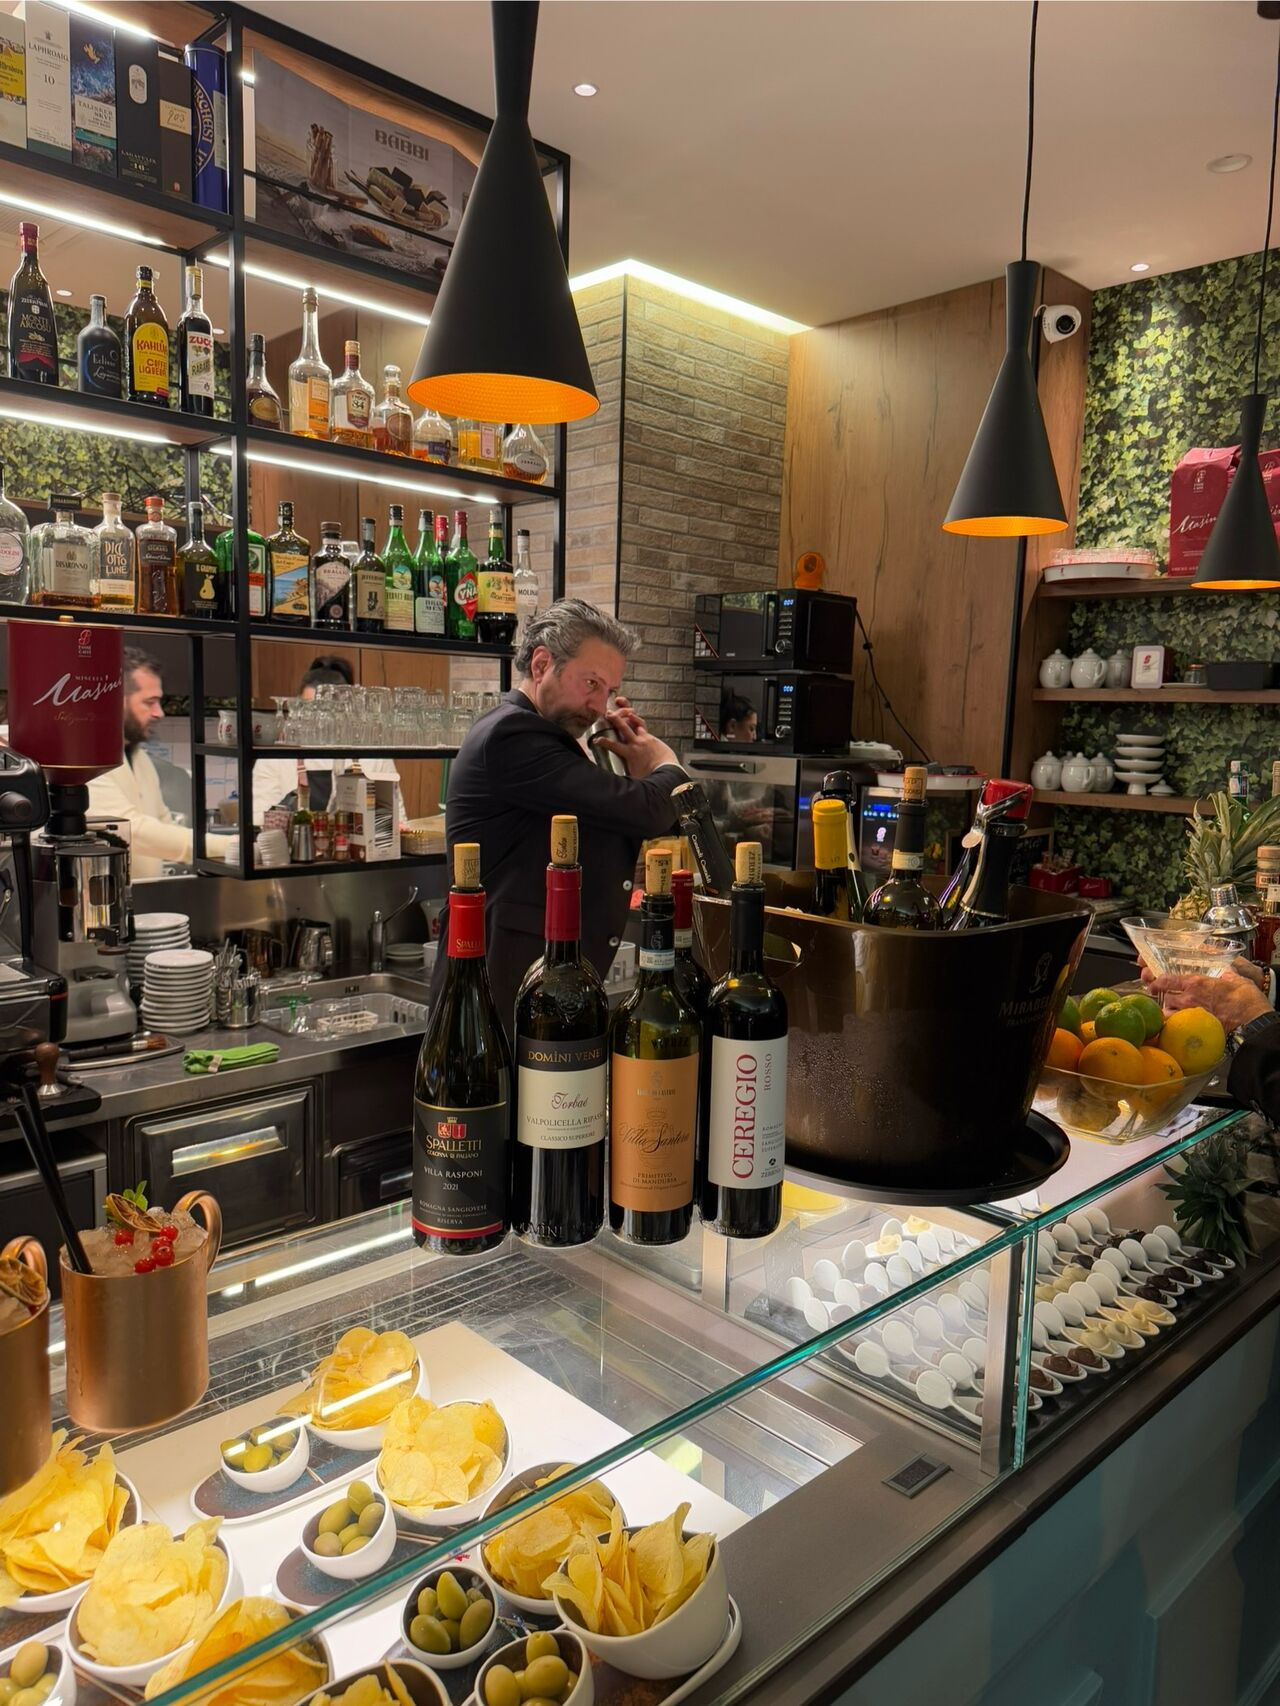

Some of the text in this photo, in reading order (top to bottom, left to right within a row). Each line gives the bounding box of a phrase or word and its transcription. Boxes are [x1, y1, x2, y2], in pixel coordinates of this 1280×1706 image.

[28, 42, 69, 62] LAPHROAIG
[44, 74, 55, 86] 10
[375, 128, 430, 161] BABBI
[55, 560, 89, 570] DISARONNO
[763, 1053, 773, 1091] ROSSO
[526, 1115, 582, 1127] VALPOLICELLA
[731, 1054, 758, 1179] CEREGIO
[426, 1135, 482, 1152] SPALLETTI
[424, 1166, 483, 1179] VILLA RASPONI
[637, 1171, 673, 1179] PRIMITIVO
[443, 1183, 459, 1191] 2021
[420, 1200, 446, 1212] ROMAGNA
[447, 1204, 487, 1213] SANGIOVESE
[437, 1217, 463, 1225] RISERVA
